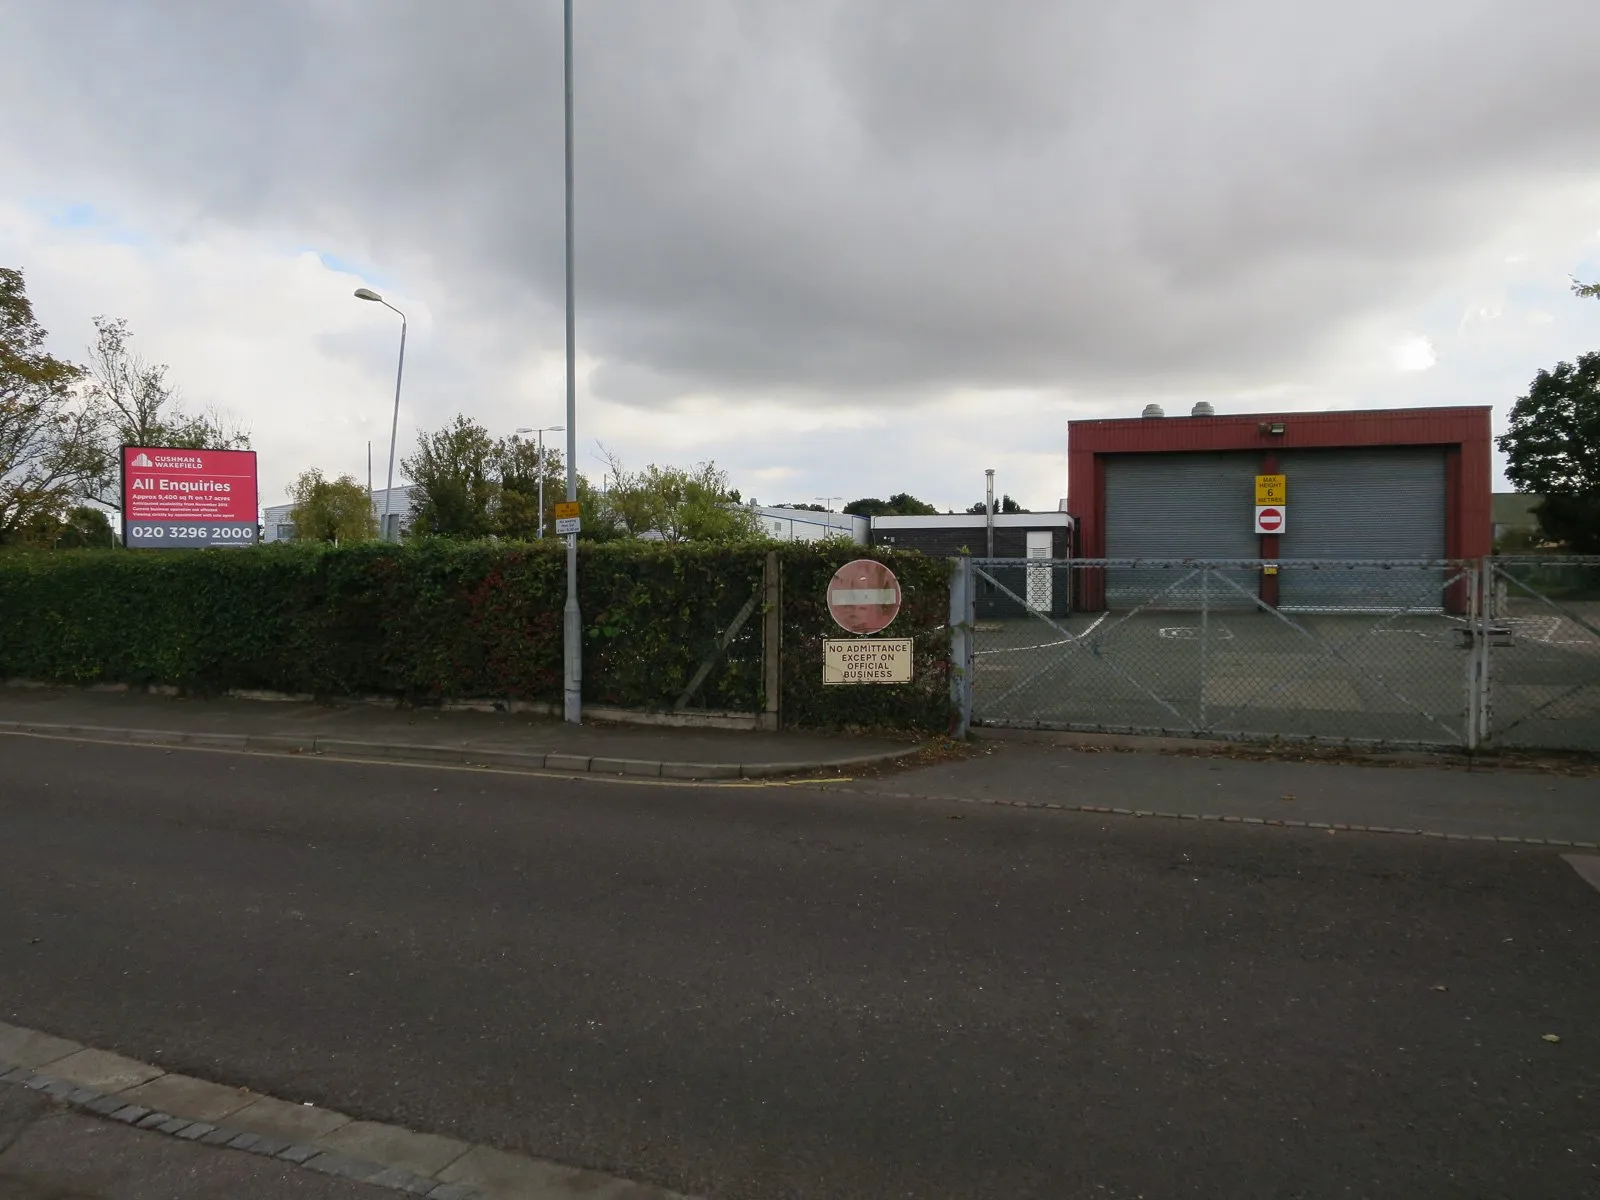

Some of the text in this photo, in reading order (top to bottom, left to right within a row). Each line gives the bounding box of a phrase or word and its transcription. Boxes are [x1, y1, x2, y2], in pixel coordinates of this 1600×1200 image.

[132, 478, 231, 492] All Enquiries
[132, 526, 252, 539] 020 3296 2000
